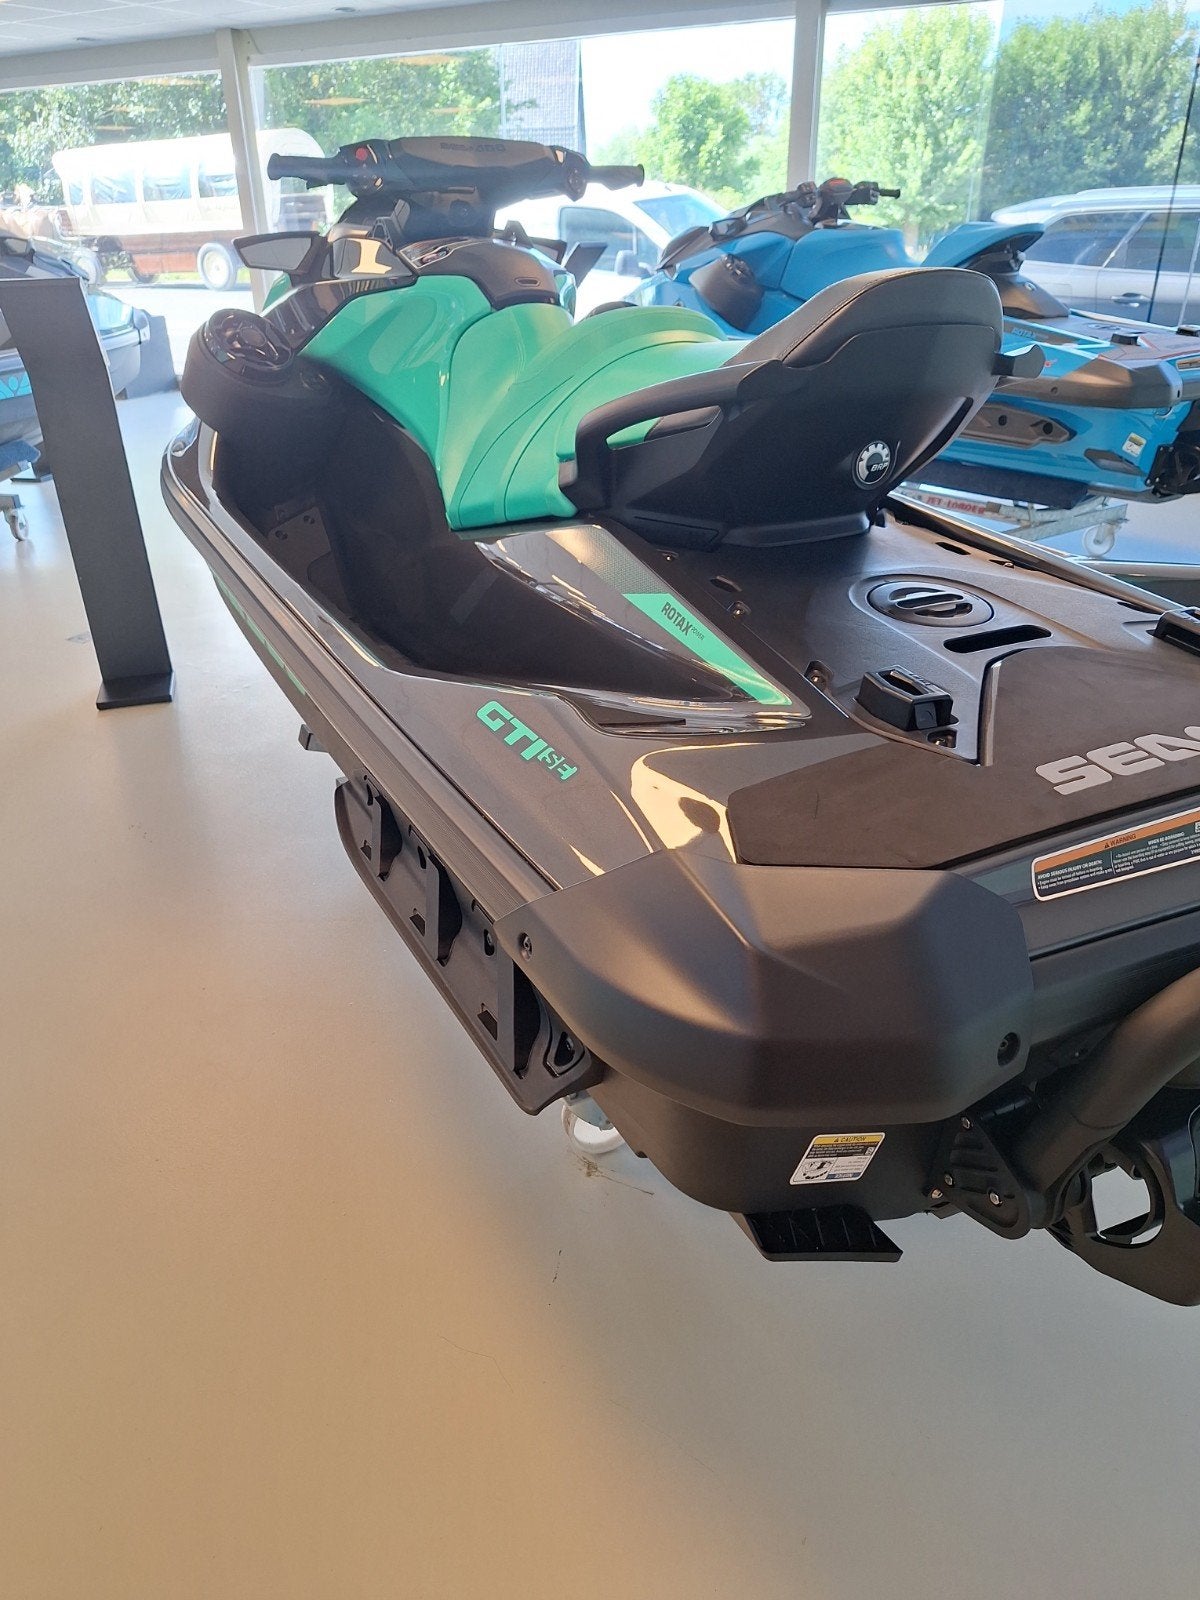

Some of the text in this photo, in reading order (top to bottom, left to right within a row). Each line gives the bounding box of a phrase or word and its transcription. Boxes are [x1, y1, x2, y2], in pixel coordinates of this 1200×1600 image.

[870, 461, 889, 472] BRP
[661, 601, 693, 637] ROTAX
[475, 699, 549, 761] GTI
[1035, 725, 1200, 796] SEA
[1110, 833, 1137, 847] WARNING
